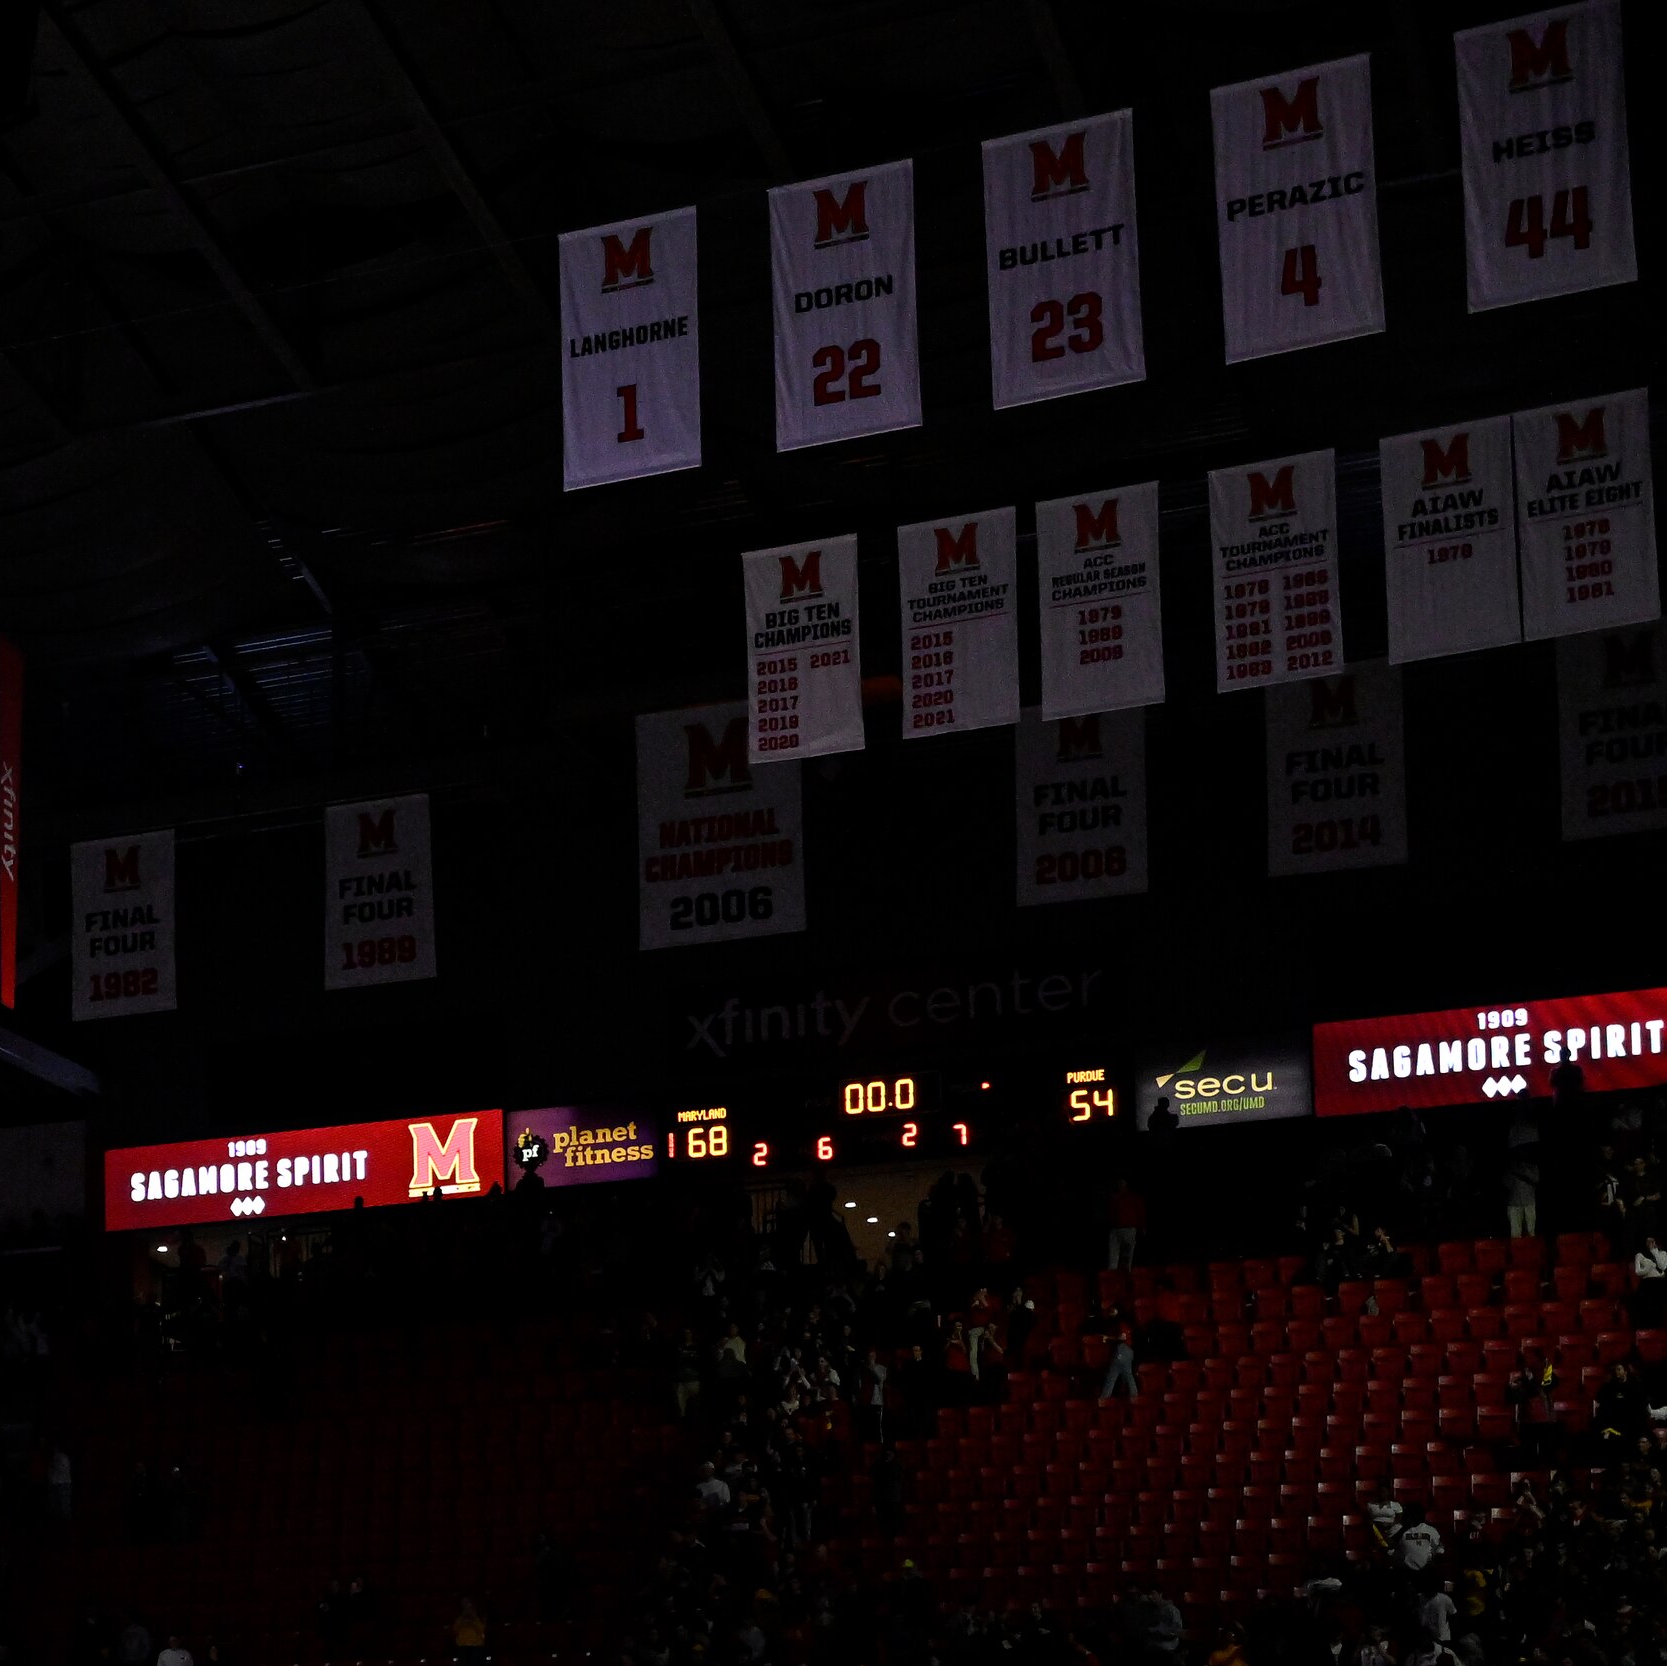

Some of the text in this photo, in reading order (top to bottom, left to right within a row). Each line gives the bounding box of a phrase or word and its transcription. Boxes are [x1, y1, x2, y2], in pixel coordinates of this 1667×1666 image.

[1259, 76, 1323, 143] M
[1491, 121, 1597, 164] HEISS
[1029, 131, 1089, 194] M
[813, 182, 869, 242] M
[1227, 171, 1365, 222] PERAZIC
[1505, 185, 1593, 259] 44
[600, 227, 654, 285] M
[999, 224, 1124, 271] BULLETT
[1280, 245, 1322, 307] 4
[795, 275, 893, 314] DORON
[570, 316, 688, 359] LANGHORNE
[1030, 291, 1103, 363] 23
[812, 338, 881, 406] 22
[617, 384, 645, 443] 1
[1555, 408, 1607, 460] M
[1420, 433, 1472, 485] M
[1247, 466, 1297, 516] M
[1545, 463, 1621, 493] AIAW
[1411, 489, 1484, 518] AIAW
[1528, 495, 1580, 518] ELITE
[1073, 499, 1120, 547] M
[1258, 522, 1290, 539] ACC
[1398, 509, 1498, 542] FINALISTS
[934, 523, 980, 570] M
[1220, 530, 1328, 559] TOURNAMENT
[1225, 545, 1325, 571] CHAMPIONS
[779, 550, 822, 596] M
[1051, 563, 1146, 589] REGULAR SEASON
[1083, 553, 1114, 569] ACC
[908, 583, 1008, 610] TOURNAMENT
[928, 575, 988, 593] BIG TEN
[1051, 576, 1148, 601] CHAMPIONS
[765, 602, 841, 629] BIG TEN
[912, 597, 1005, 624] CHAMPIONS
[754, 619, 851, 650] CHAMPIONS
[757, 650, 850, 674] 2015 2021
[912, 670, 954, 688] 2017
[758, 697, 798, 713] 2017
[913, 709, 955, 728] 2021
[759, 734, 799, 751] 2020
[1285, 743, 1385, 774] FINAL
[1033, 776, 1127, 807] FINAL
[1291, 773, 1379, 804] FOUR
[1, 761, 16, 881] xfinity
[357, 809, 396, 852] M
[659, 808, 779, 850] NATIONAL
[1039, 805, 1121, 835] FOUR
[1292, 815, 1381, 855] 2014
[104, 845, 141, 886] M
[645, 839, 793, 883] CHAMPIONS
[339, 870, 416, 899] FINAL
[85, 905, 159, 932] FINAL
[343, 897, 413, 925] FOUR
[670, 886, 773, 930] 2006
[90, 931, 155, 958] FOUR
[343, 935, 416, 969] 1989
[90, 967, 157, 1002] 1982
[685, 967, 1103, 1059] xfinity center
[1478, 1008, 1528, 1029] 1909
[1348, 1019, 1664, 1083] SAGAMORE SPIRIT
[1067, 1069, 1105, 1083] PURDUE
[1173, 1069, 1273, 1100] secu
[845, 1079, 914, 1114] 00.0
[1071, 1089, 1114, 1122] 54
[1179, 1096, 1265, 1118] SECUMD.ORG/UMD
[678, 1107, 726, 1122] MARYLAND
[553, 1121, 637, 1153] planet
[688, 1126, 727, 1158] 68
[818, 1137, 833, 1160] 6
[902, 1123, 967, 1146] 2 7
[409, 1119, 479, 1189] M
[521, 1142, 540, 1161] pf
[565, 1141, 653, 1168] fitness
[753, 1143, 767, 1166] 2
[131, 1150, 368, 1201] SAGAMORE SPIRIT
